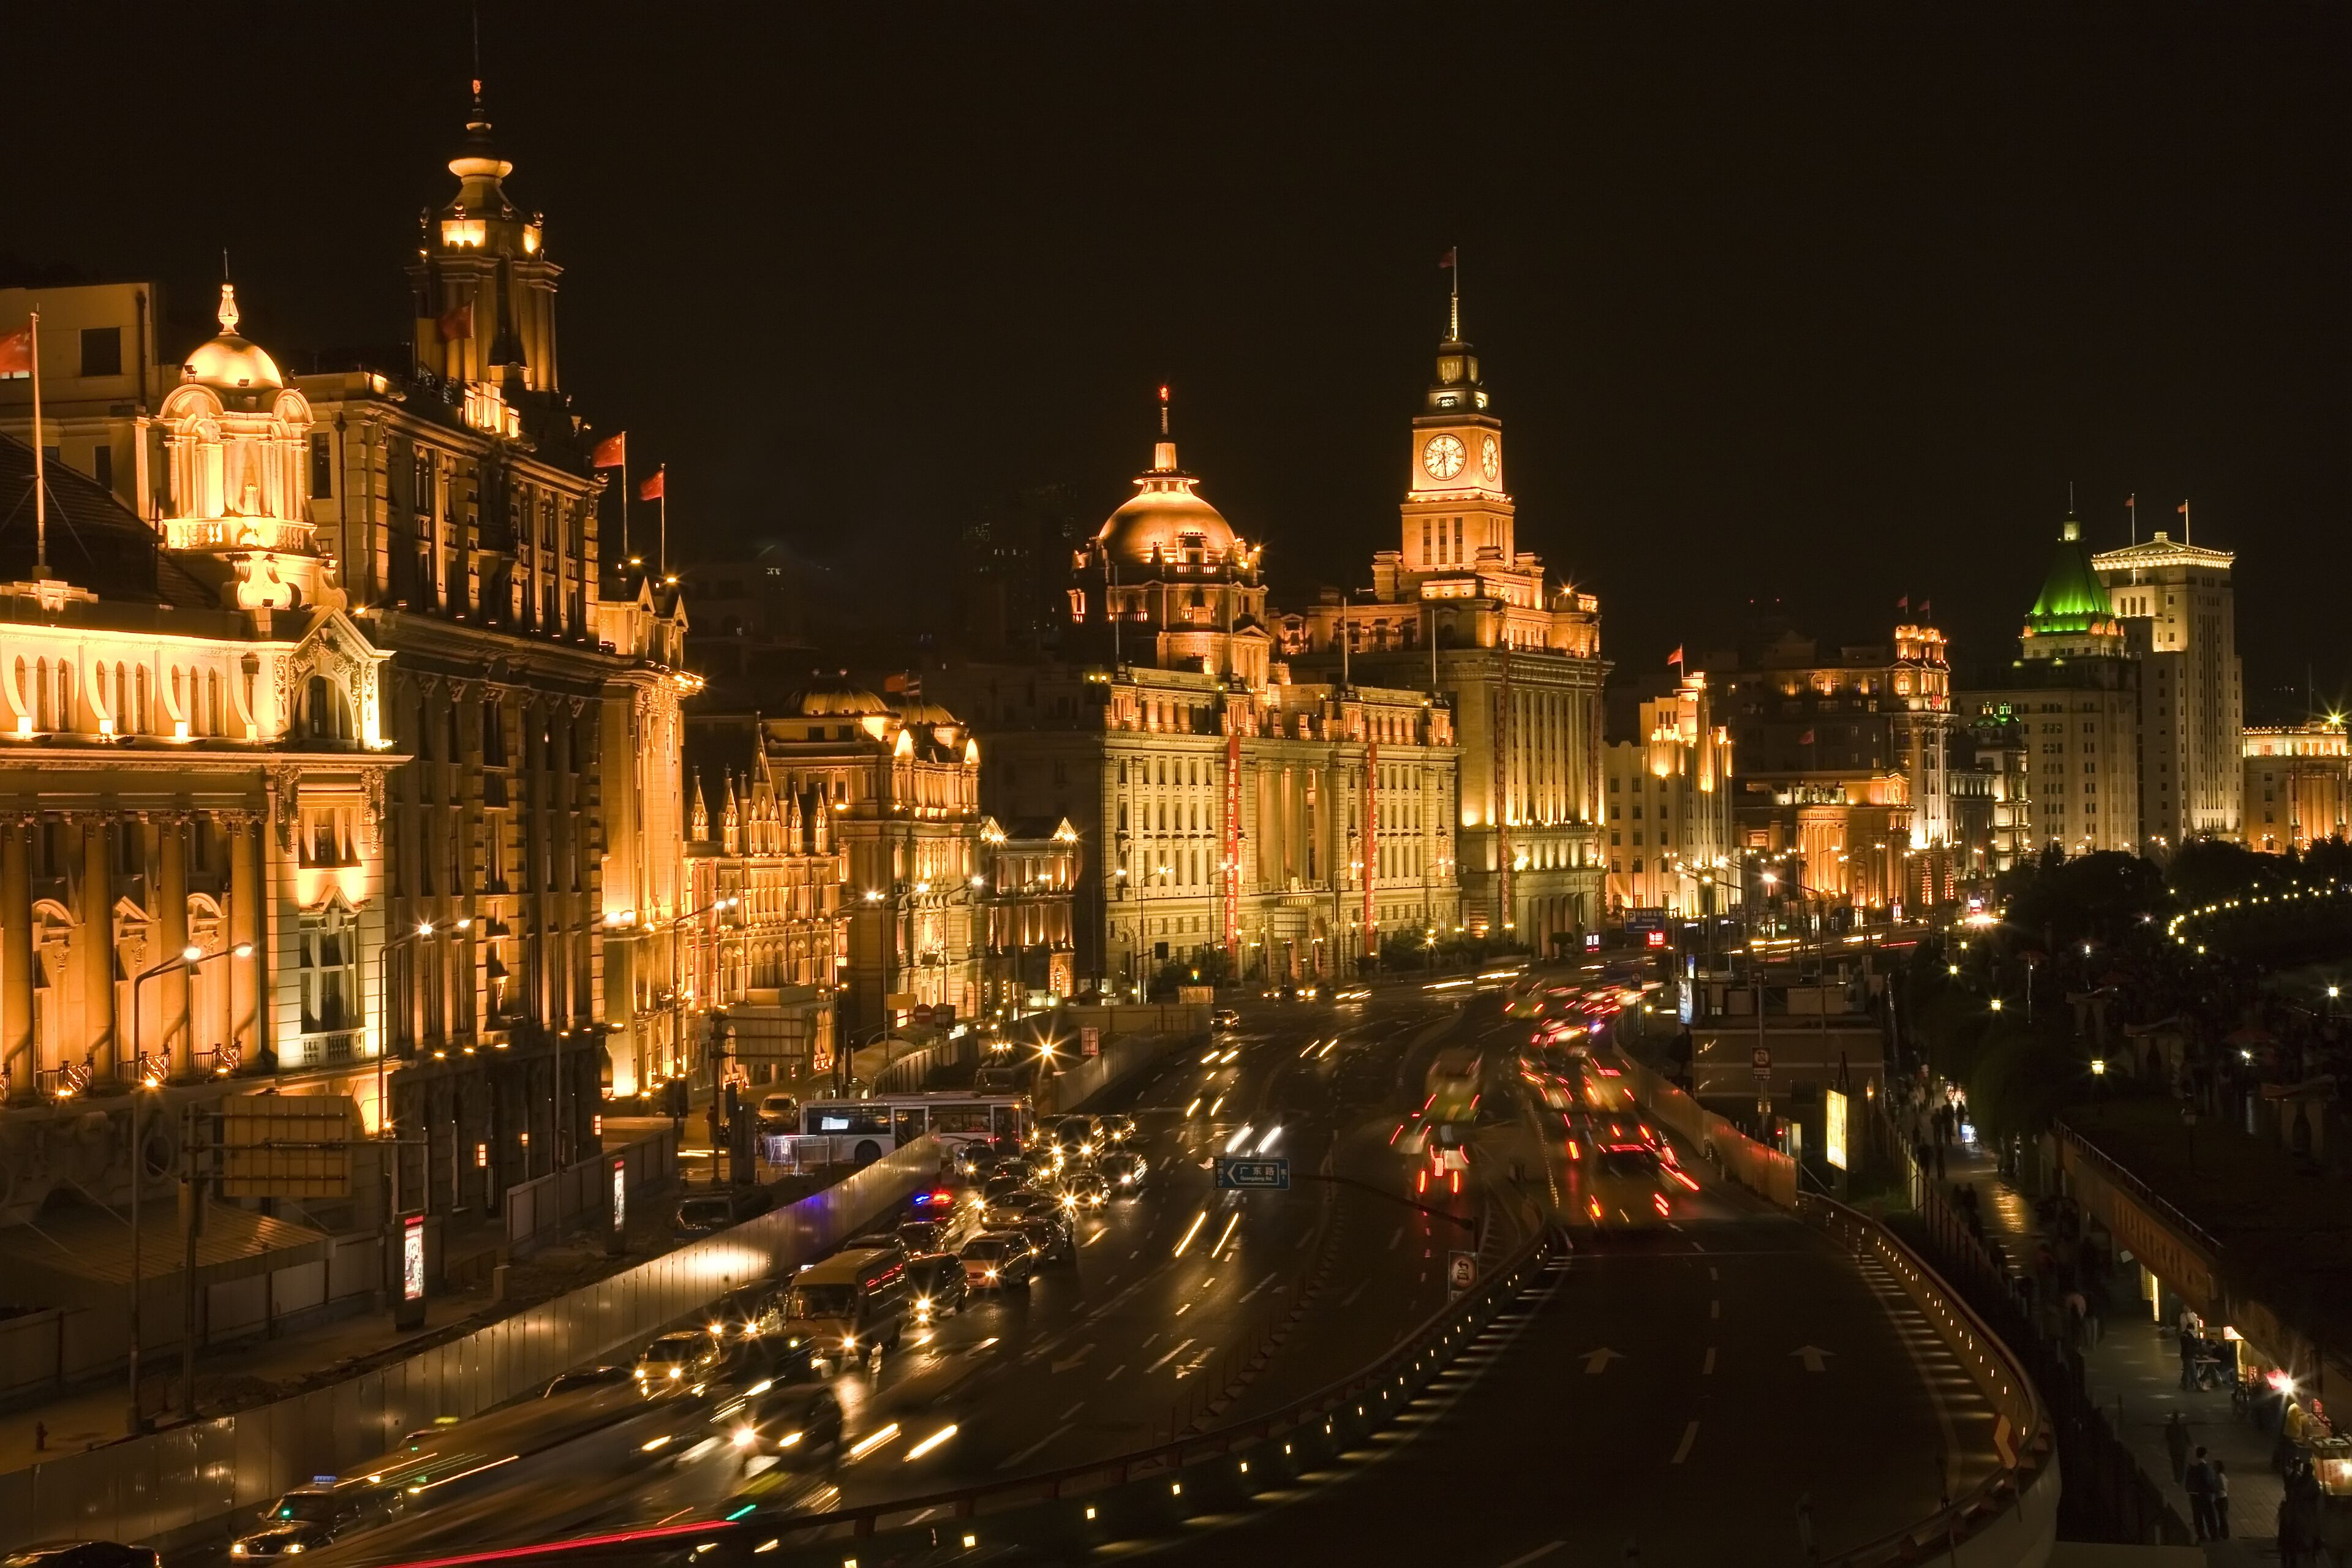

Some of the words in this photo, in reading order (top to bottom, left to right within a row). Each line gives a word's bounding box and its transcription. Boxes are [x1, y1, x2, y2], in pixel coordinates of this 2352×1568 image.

[1628, 912, 1634, 921] P
[1240, 1166, 1275, 1176] 广东路
